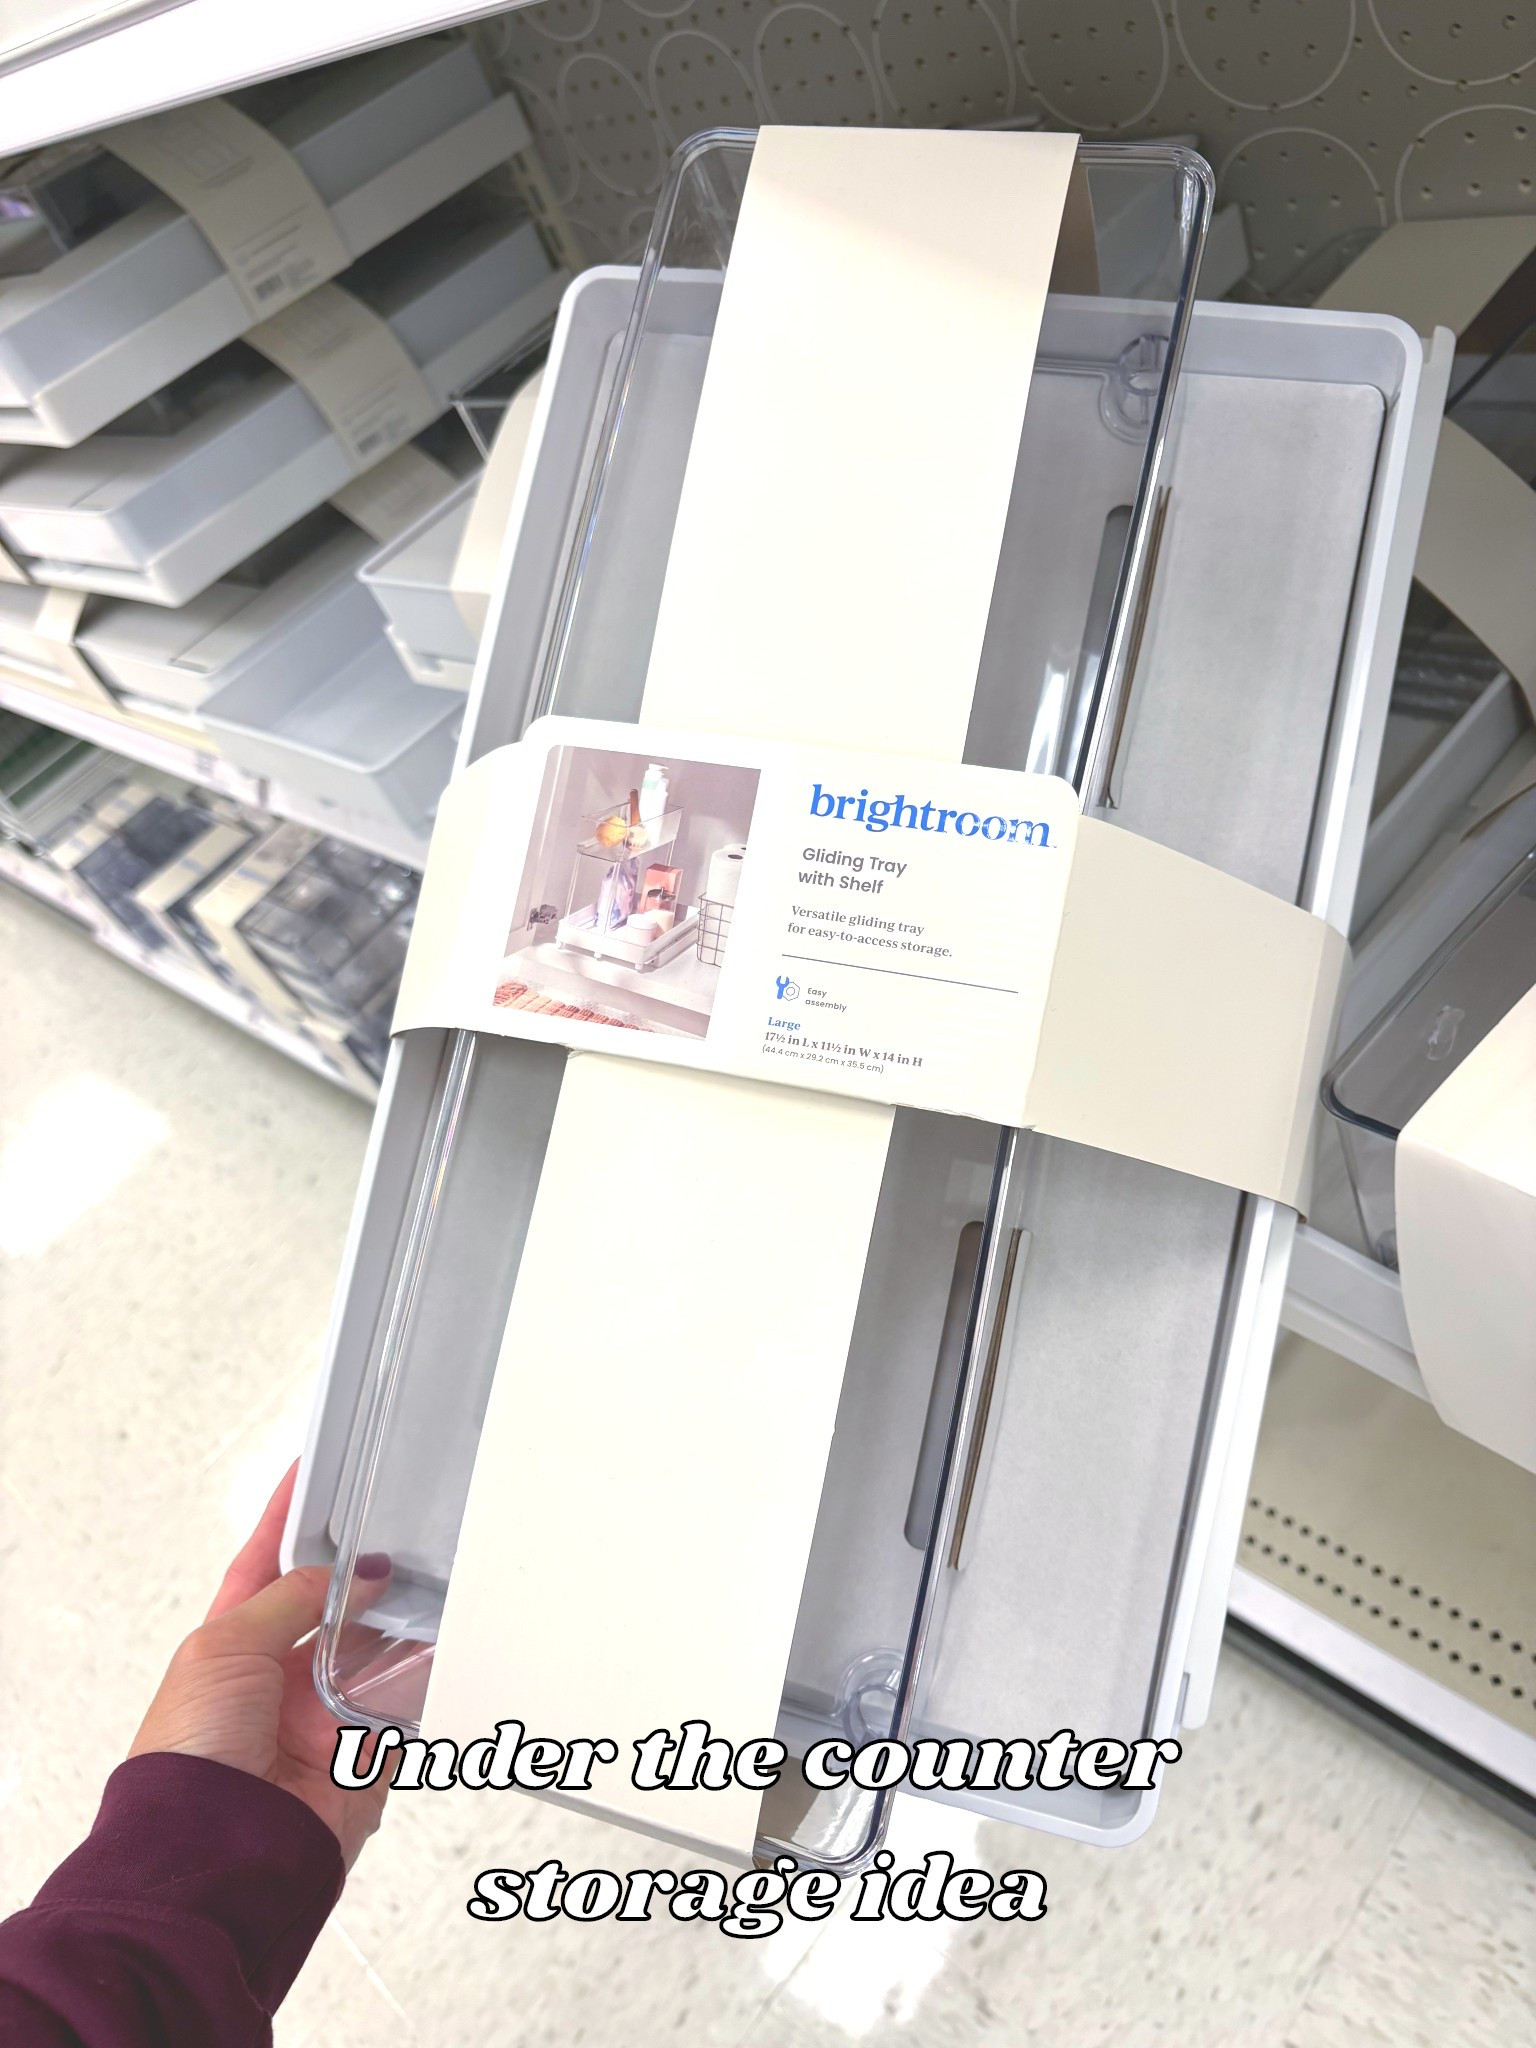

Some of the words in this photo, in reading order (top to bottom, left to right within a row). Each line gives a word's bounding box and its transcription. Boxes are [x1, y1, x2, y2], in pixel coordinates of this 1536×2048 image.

[802, 847, 865, 872] Gliding
[869, 856, 907, 878] Tray
[798, 870, 835, 887] with
[838, 875, 884, 894] Shelf
[792, 905, 847, 923] Versatile
[848, 913, 896, 932] gliding
[898, 921, 925, 936] tray
[787, 922, 807, 934] for
[808, 927, 898, 949] easy-to-access
[900, 939, 953, 957] storage.
[805, 998, 848, 1013] assembly
[807, 987, 828, 998] Easy
[768, 1016, 801, 1031] Large
[762, 1044, 783, 1055] (44.4
[784, 1050, 799, 1059] cm
[805, 1052, 824, 1063] 29.2
[825, 1057, 839, 1065] cm
[846, 1060, 865, 1070] 35.5
[866, 1064, 884, 1074] cm)
[787, 1034, 800, 1046] in
[801, 1037, 810, 1048] L
[810, 1041, 819, 1049] x
[843, 1043, 856, 1056] in
[859, 1047, 872, 1058] W
[872, 1050, 881, 1060] x
[881, 1050, 895, 1062] 14
[896, 1053, 910, 1065] in
[911, 1056, 923, 1067] H
